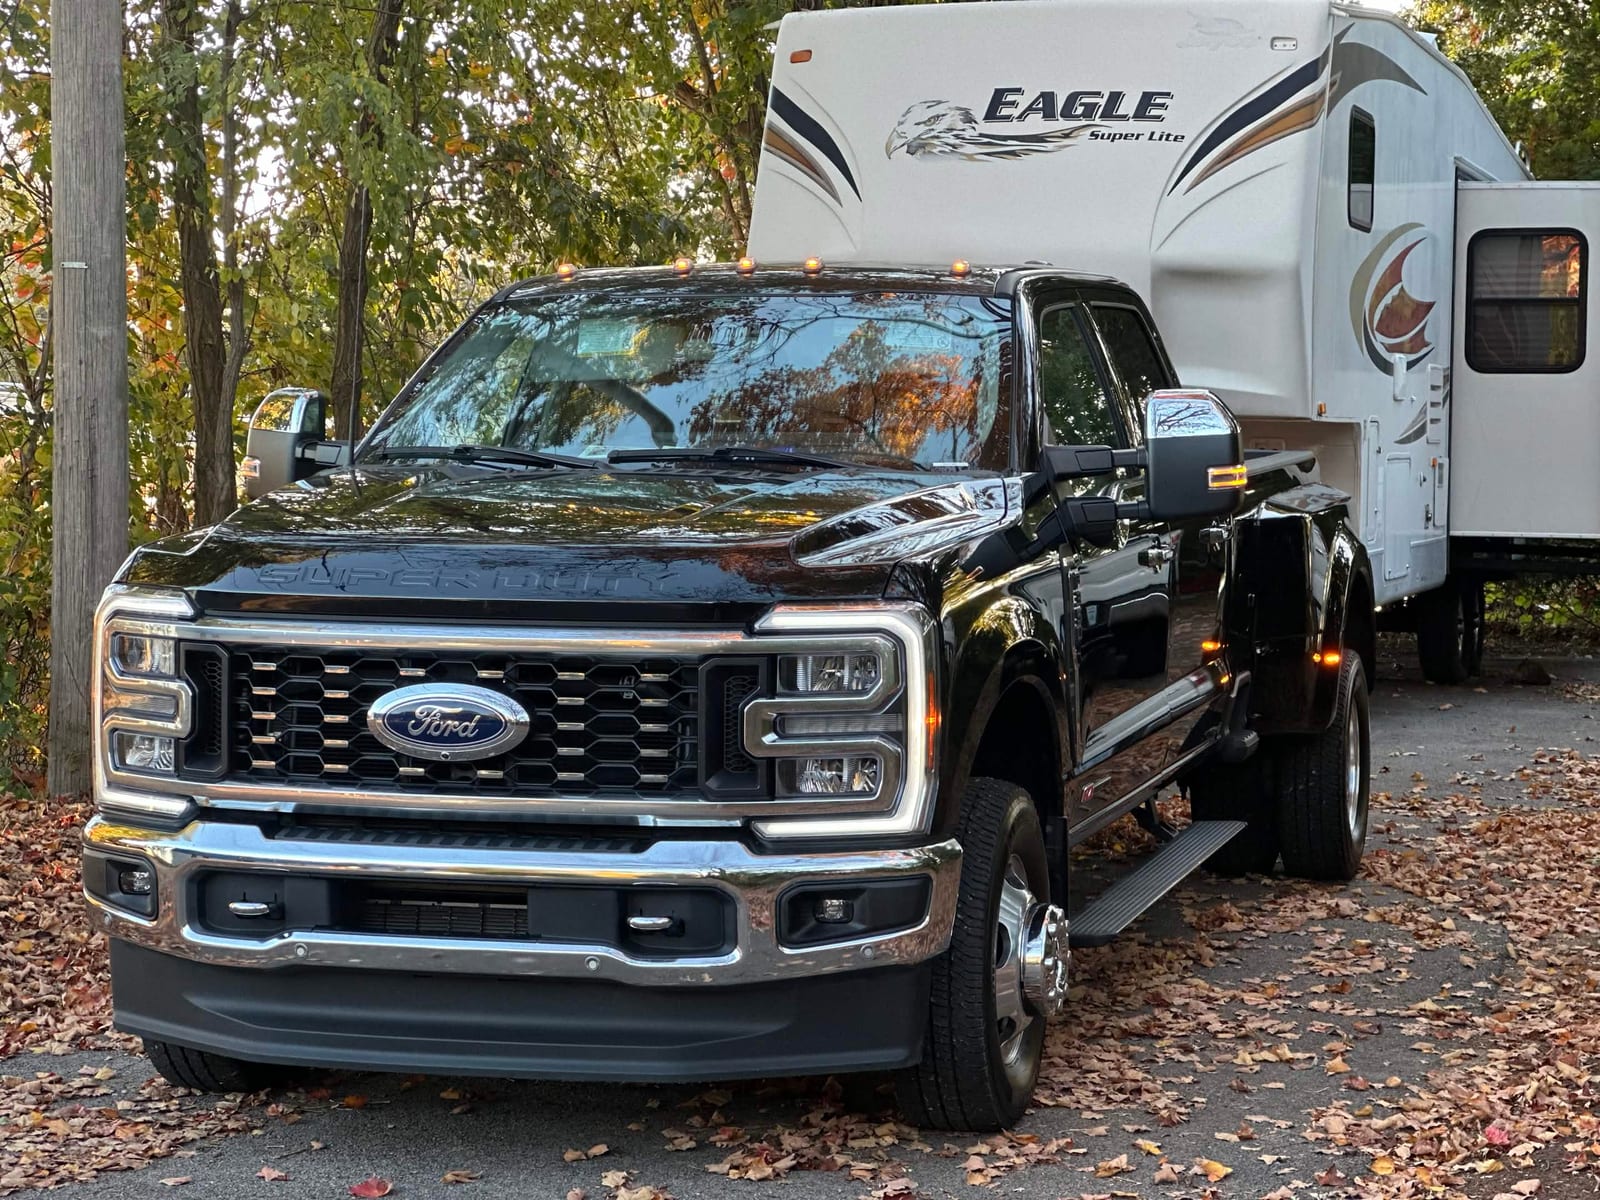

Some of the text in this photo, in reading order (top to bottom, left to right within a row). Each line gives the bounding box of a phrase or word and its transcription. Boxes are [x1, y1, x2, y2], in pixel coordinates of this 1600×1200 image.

[982, 87, 1174, 123] EAGLE
[1087, 130, 1186, 143] Super Lite
[258, 564, 681, 592] SUPER DUTY
[407, 704, 481, 738] Ford
